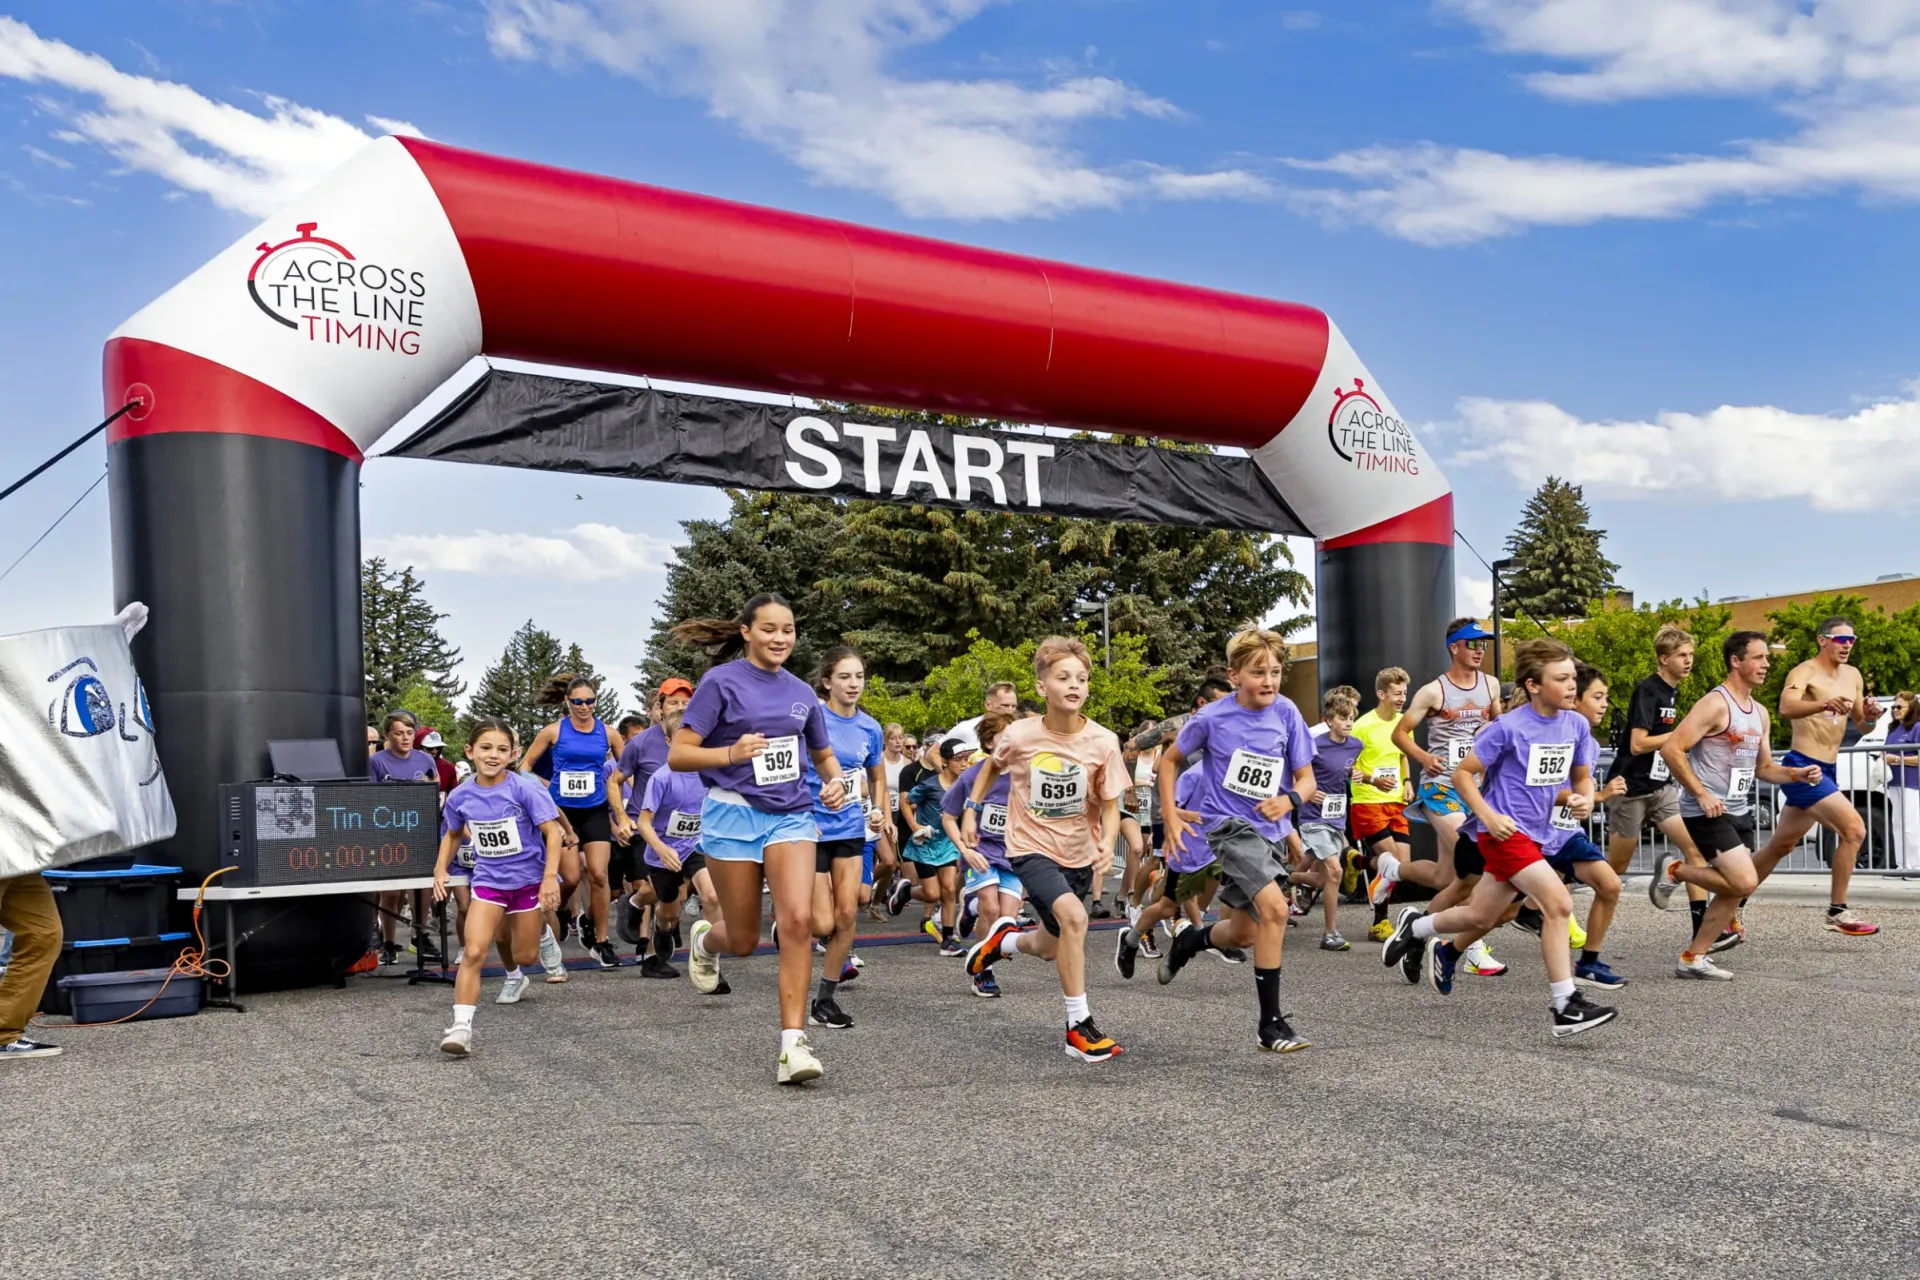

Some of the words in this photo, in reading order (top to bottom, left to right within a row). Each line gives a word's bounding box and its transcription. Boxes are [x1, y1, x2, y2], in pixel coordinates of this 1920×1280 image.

[283, 259, 426, 298] ACROSS
[268, 283, 340, 313] THE
[353, 290, 425, 327] LINE
[301, 314, 421, 356] TIMING
[1348, 409, 1411, 439] ACROSS
[1340, 428, 1377, 450] THE
[1382, 433, 1416, 457] LINE
[784, 415, 1056, 508] START
[1354, 451, 1419, 476] TIMING
[1459, 709, 1482, 718] TETON
[764, 750, 793, 772] 592
[1538, 756, 1566, 775] 552
[567, 779, 588, 791] 641
[1228, 782, 1237, 790] TIN
[1237, 786, 1247, 794] CUP
[1237, 765, 1273, 789] 683
[1041, 781, 1078, 800] 639
[1327, 801, 1342, 812] 616
[326, 806, 363, 830] Tin
[372, 805, 420, 833] Cup
[676, 820, 702, 832] 642
[478, 830, 511, 847] 698
[288, 842, 409, 871] 00:00:00
